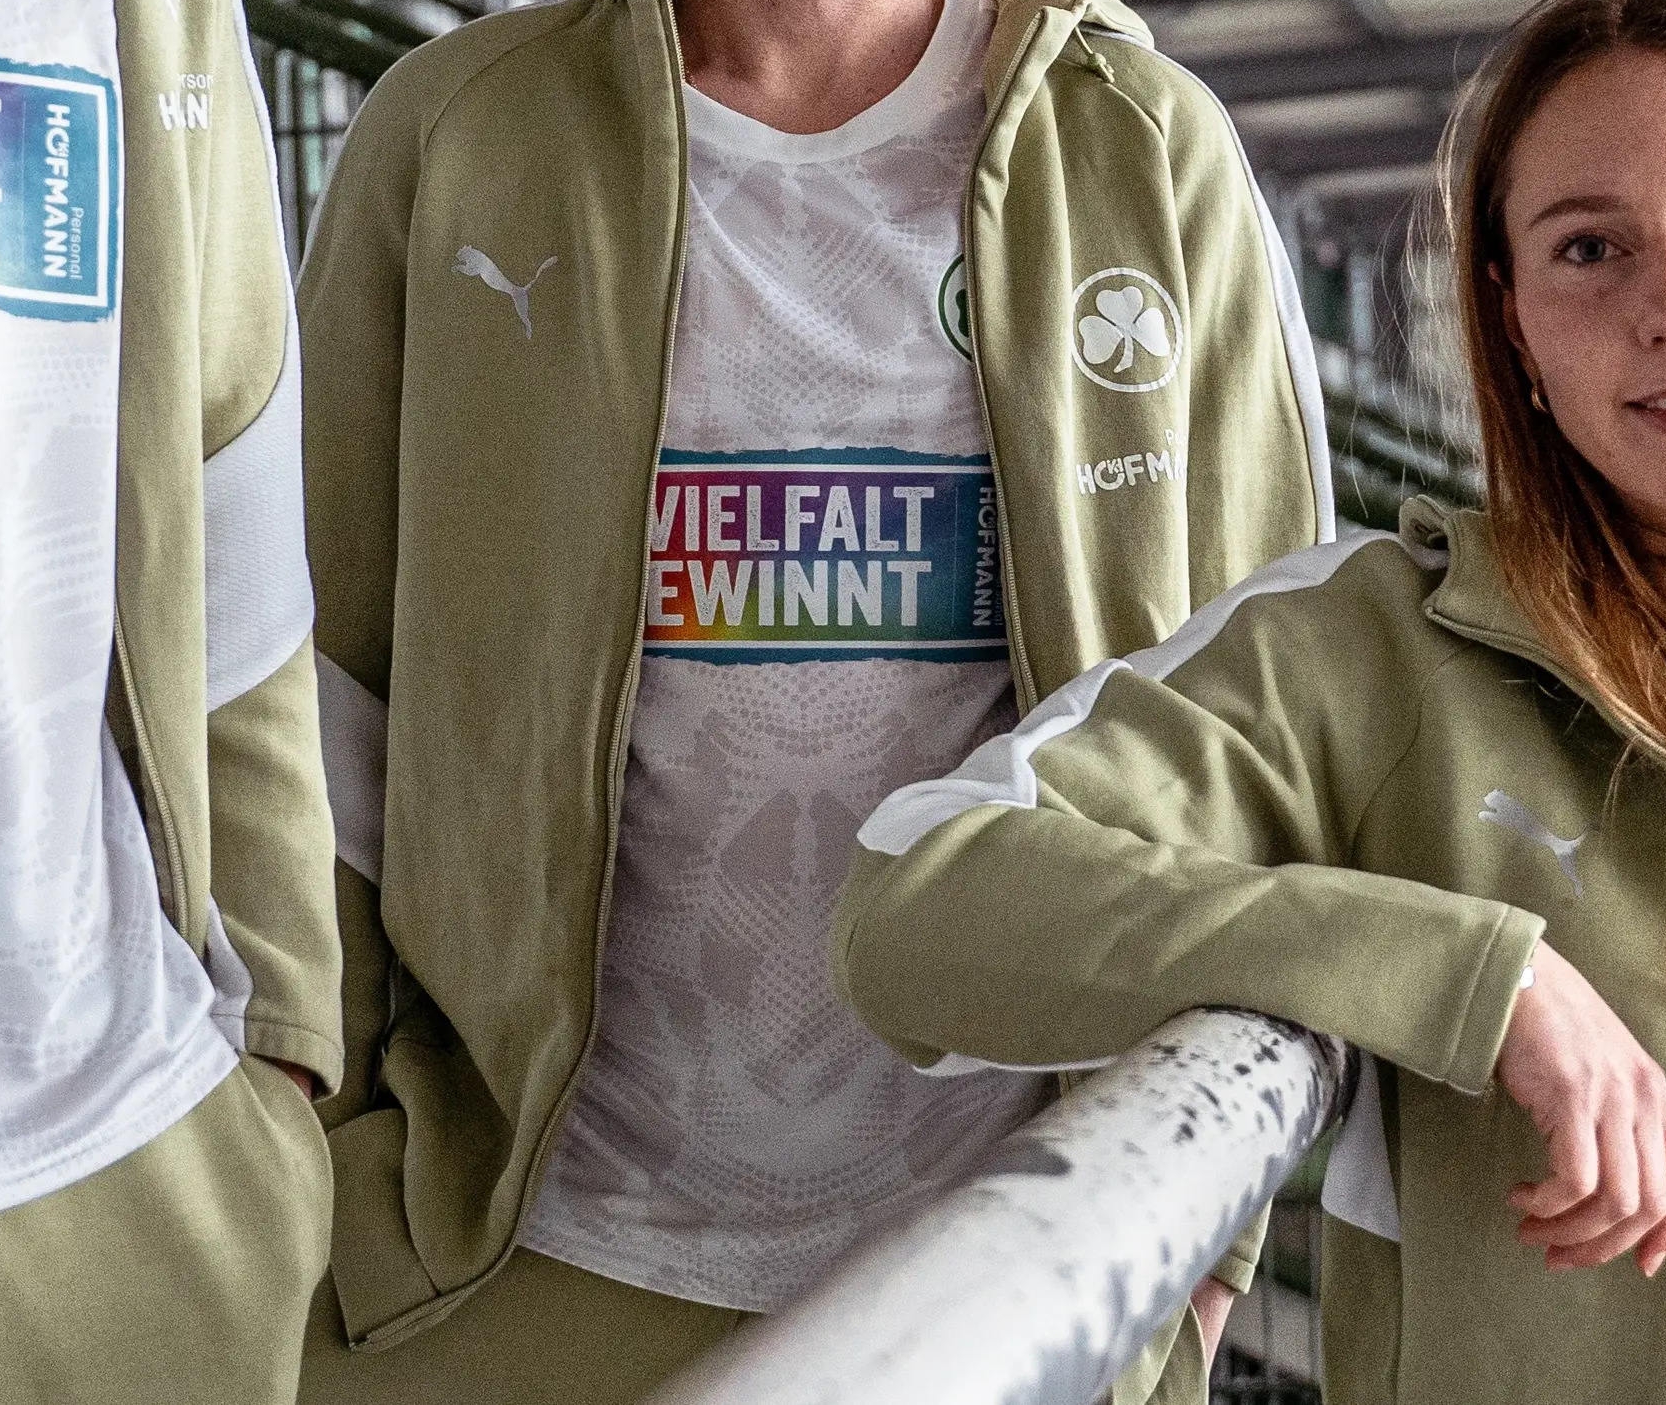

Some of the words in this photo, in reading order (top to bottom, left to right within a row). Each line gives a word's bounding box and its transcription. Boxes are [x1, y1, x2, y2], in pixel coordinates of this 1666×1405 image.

[44, 104, 70, 278] HOFMANN
[70, 207, 84, 280] Personal
[651, 484, 935, 554] VIELFALT
[647, 559, 933, 628] EWINNT
